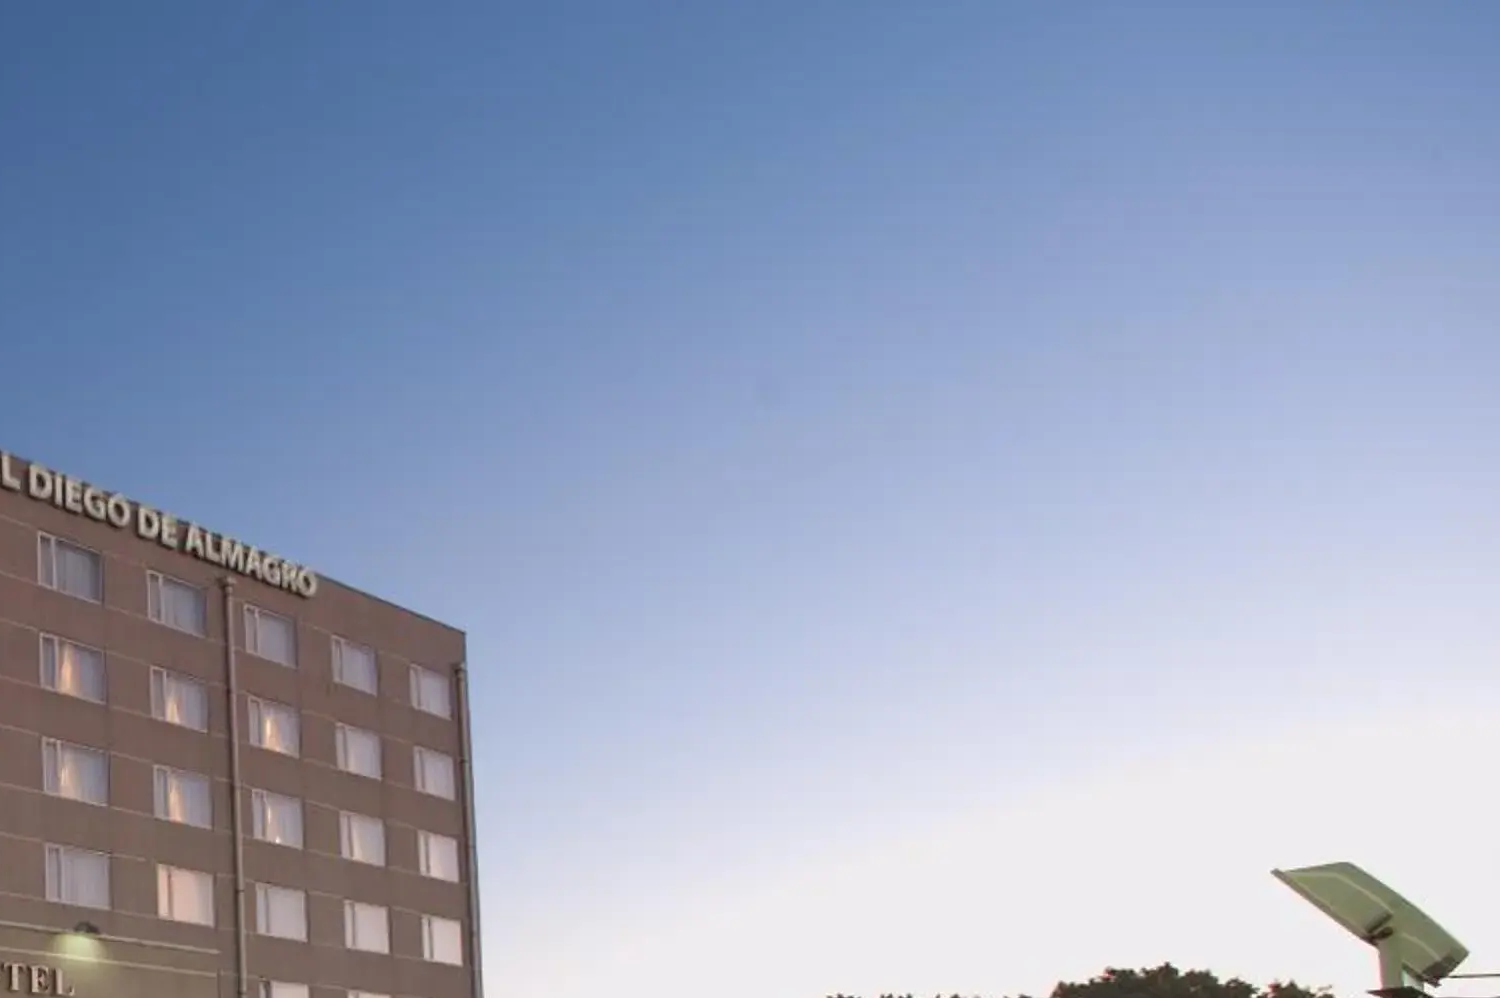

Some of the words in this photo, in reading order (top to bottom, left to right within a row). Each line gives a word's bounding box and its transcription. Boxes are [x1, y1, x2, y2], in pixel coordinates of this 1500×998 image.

[29, 464, 131, 529] DIEGO
[138, 507, 178, 549] DE
[186, 524, 318, 598] ALMAGRO
